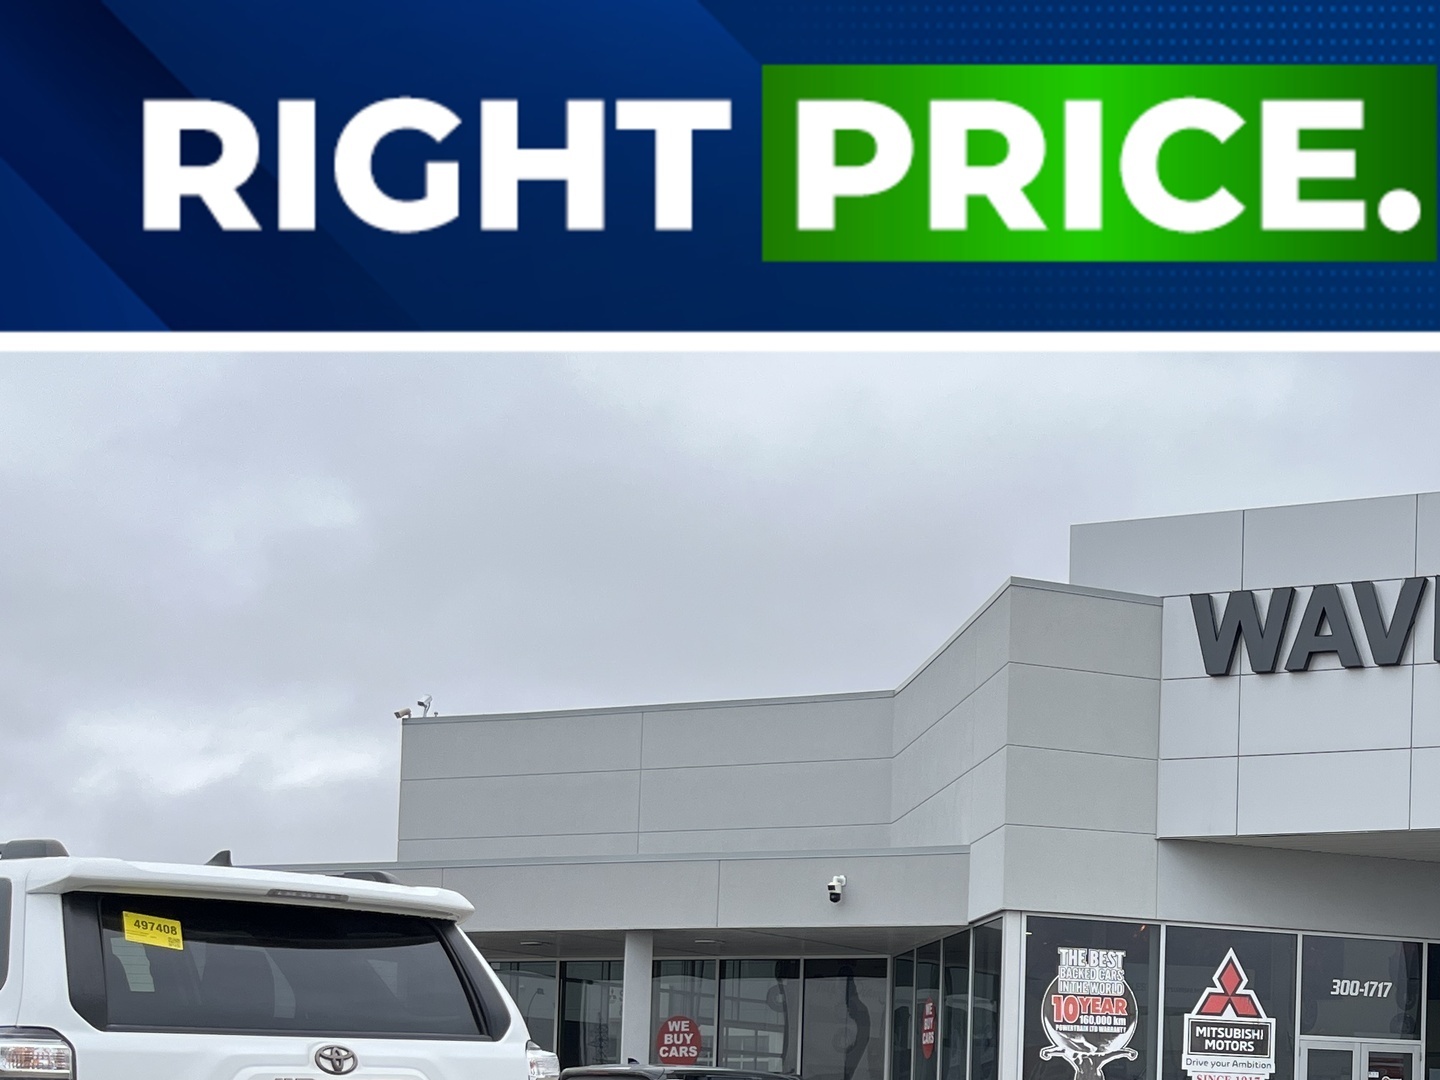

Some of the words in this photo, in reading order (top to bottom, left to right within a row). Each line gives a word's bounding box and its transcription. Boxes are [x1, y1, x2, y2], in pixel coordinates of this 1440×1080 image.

[134, 920, 177, 935] 497408
[1058, 947, 1087, 966] THE
[1089, 949, 1126, 969] BEST
[1059, 967, 1096, 980] BACKED
[1060, 981, 1069, 993] IN
[1070, 981, 1088, 994] THE
[1090, 982, 1124, 996] WORLD
[1330, 979, 1392, 998] 300-1717
[1052, 995, 1080, 1023] 10
[1078, 996, 1128, 1015] YEAR
[668, 1021, 690, 1032] WE
[1080, 1015, 1112, 1026] 160,000
[1113, 1016, 1126, 1026] km
[664, 1033, 694, 1045] BUY
[1195, 1026, 1264, 1040] MITSUBISHI
[659, 1046, 698, 1058] CARS
[1204, 1039, 1254, 1052] MOTORS
[1186, 1058, 1209, 1067] Drive
[1232, 1060, 1272, 1069] Ambition
